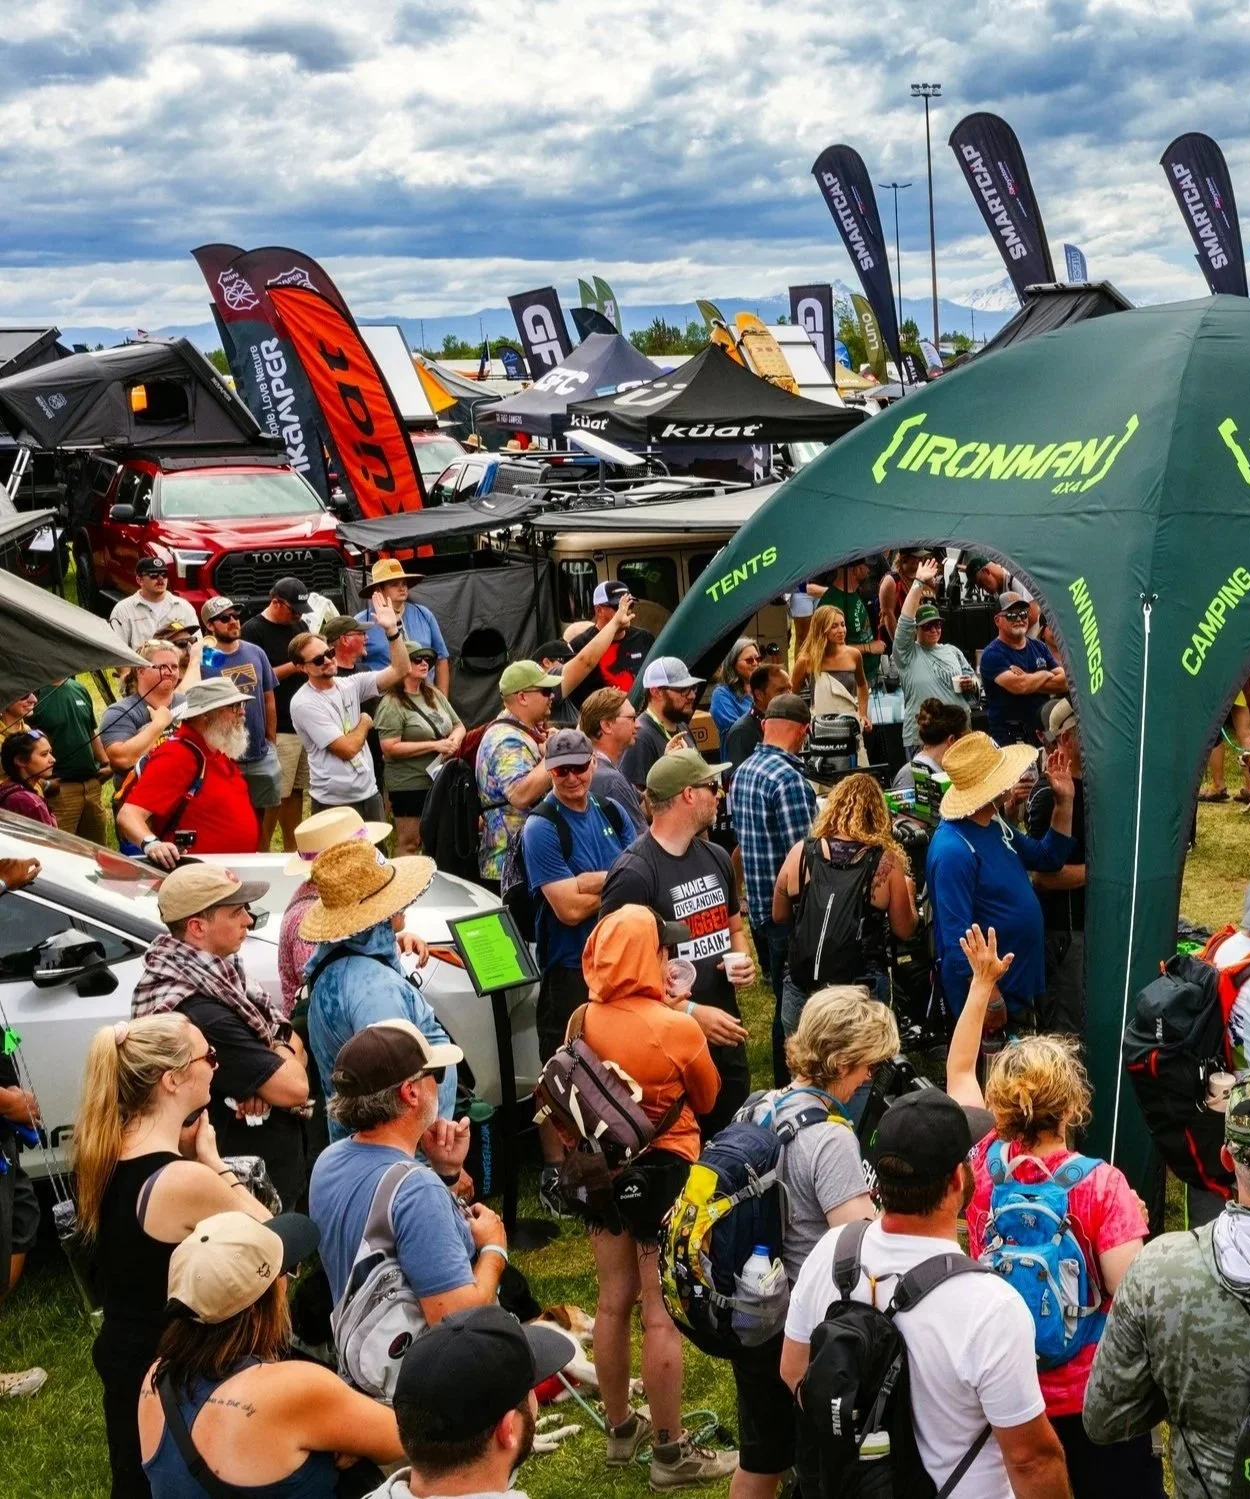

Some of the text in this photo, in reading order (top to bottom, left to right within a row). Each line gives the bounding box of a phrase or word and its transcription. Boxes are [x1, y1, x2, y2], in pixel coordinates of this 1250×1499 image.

[822, 171, 874, 271] SMARTCAP
[962, 144, 1027, 261] SMARTCAP
[1172, 163, 1228, 270] SMARTCAP
[522, 303, 570, 368] GF
[249, 345, 268, 383] Nature
[570, 415, 608, 431] küat
[662, 424, 763, 439] küat
[897, 432, 1116, 481] IRONMAN
[252, 550, 314, 563] TOYOTA
[705, 546, 777, 602] TENTS
[1068, 576, 1104, 696] AWNINGS
[675, 890, 724, 918] OVERLANDING
[680, 906, 728, 939] UGGED
[693, 933, 724, 959] AGAIN
[832, 1397, 842, 1437] THULE
